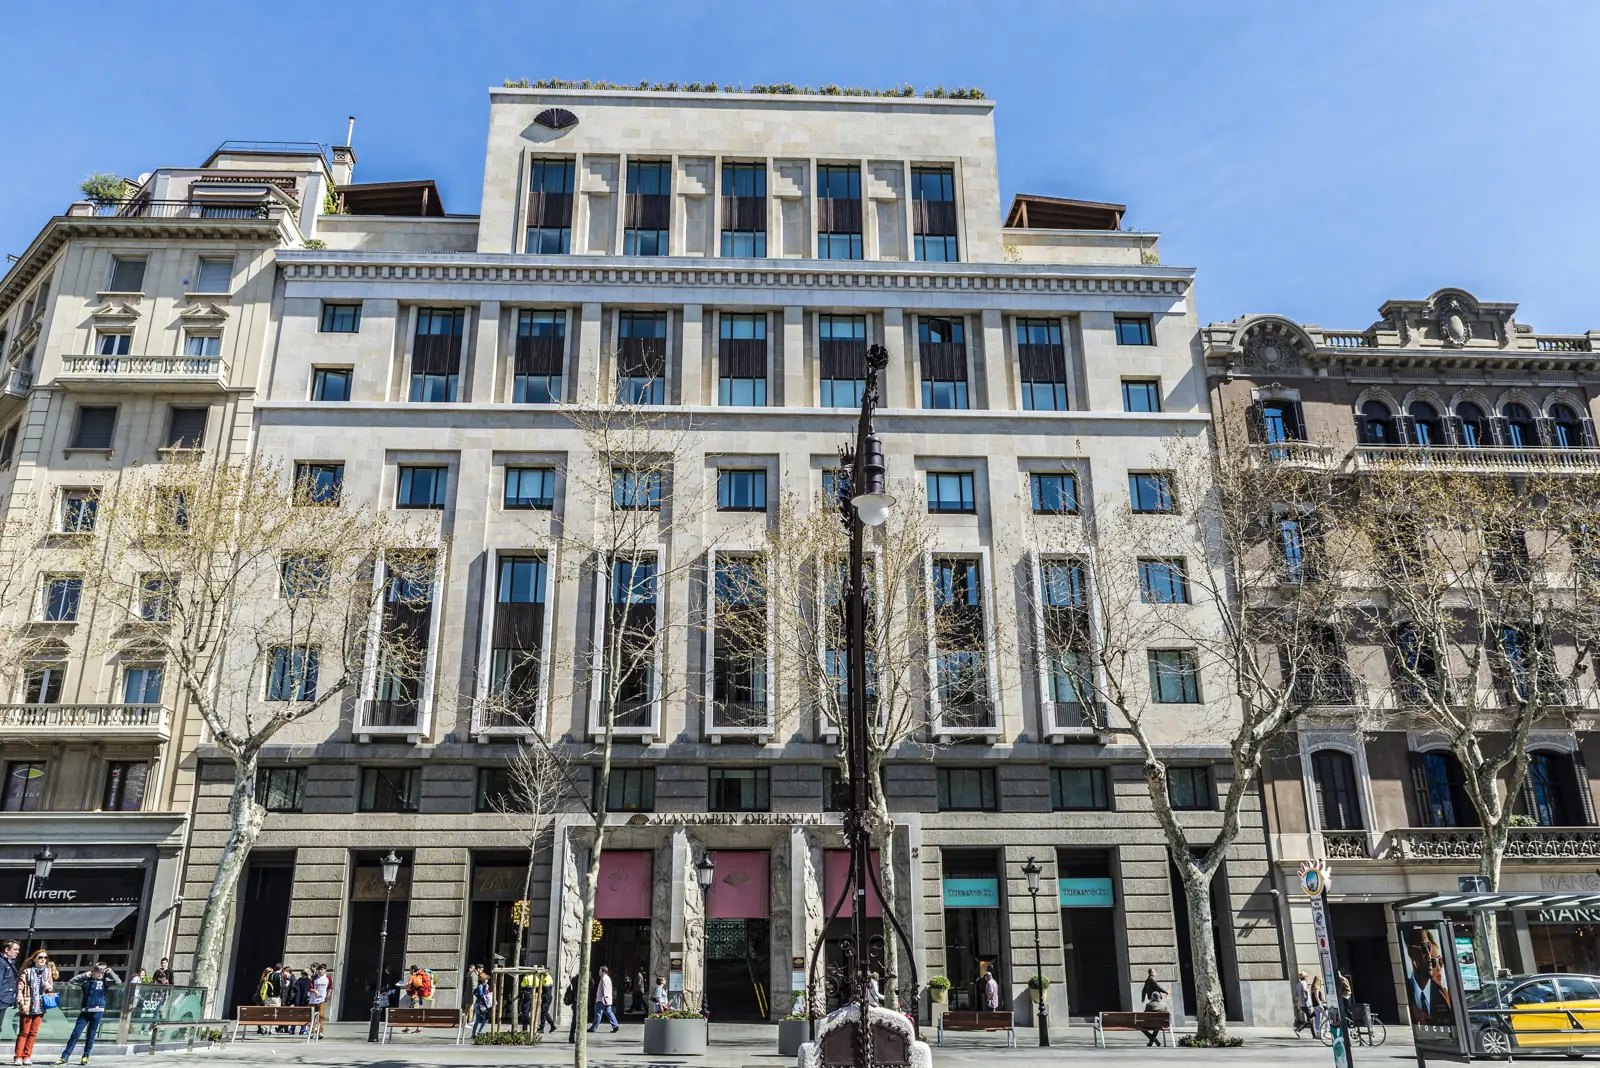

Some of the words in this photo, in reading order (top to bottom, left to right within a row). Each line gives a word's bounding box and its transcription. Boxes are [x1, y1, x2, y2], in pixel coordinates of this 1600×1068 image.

[656, 813, 738, 824] MANDARIN
[745, 813, 827, 824] ORIENTAL
[25, 874, 77, 900] llorenç
[95, 981, 104, 990] R
